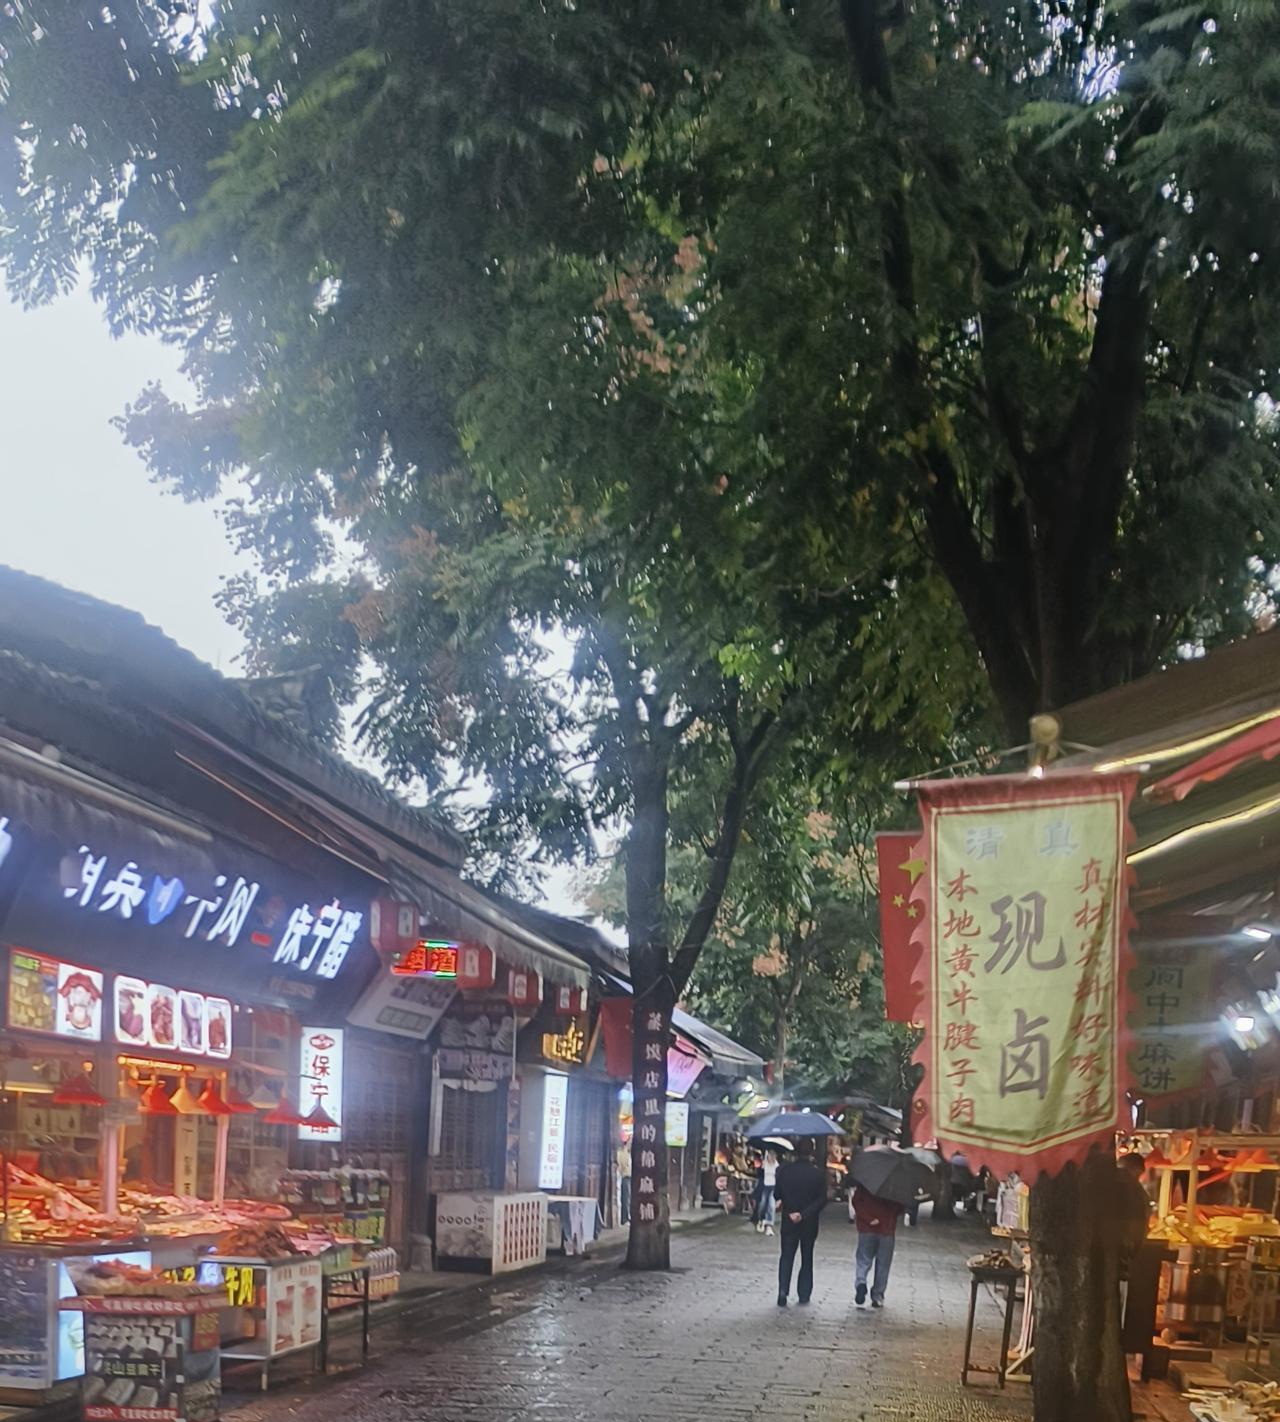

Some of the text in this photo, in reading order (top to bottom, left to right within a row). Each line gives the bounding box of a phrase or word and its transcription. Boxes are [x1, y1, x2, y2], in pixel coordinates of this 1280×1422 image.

[273, 897, 364, 979] 保宁醋
[966, 819, 1080, 860] 清真
[942, 868, 982, 1124] 本地黄牛腱子肉
[983, 890, 1068, 1101] 现卤
[1070, 857, 1107, 1120] 真材实料好味道
